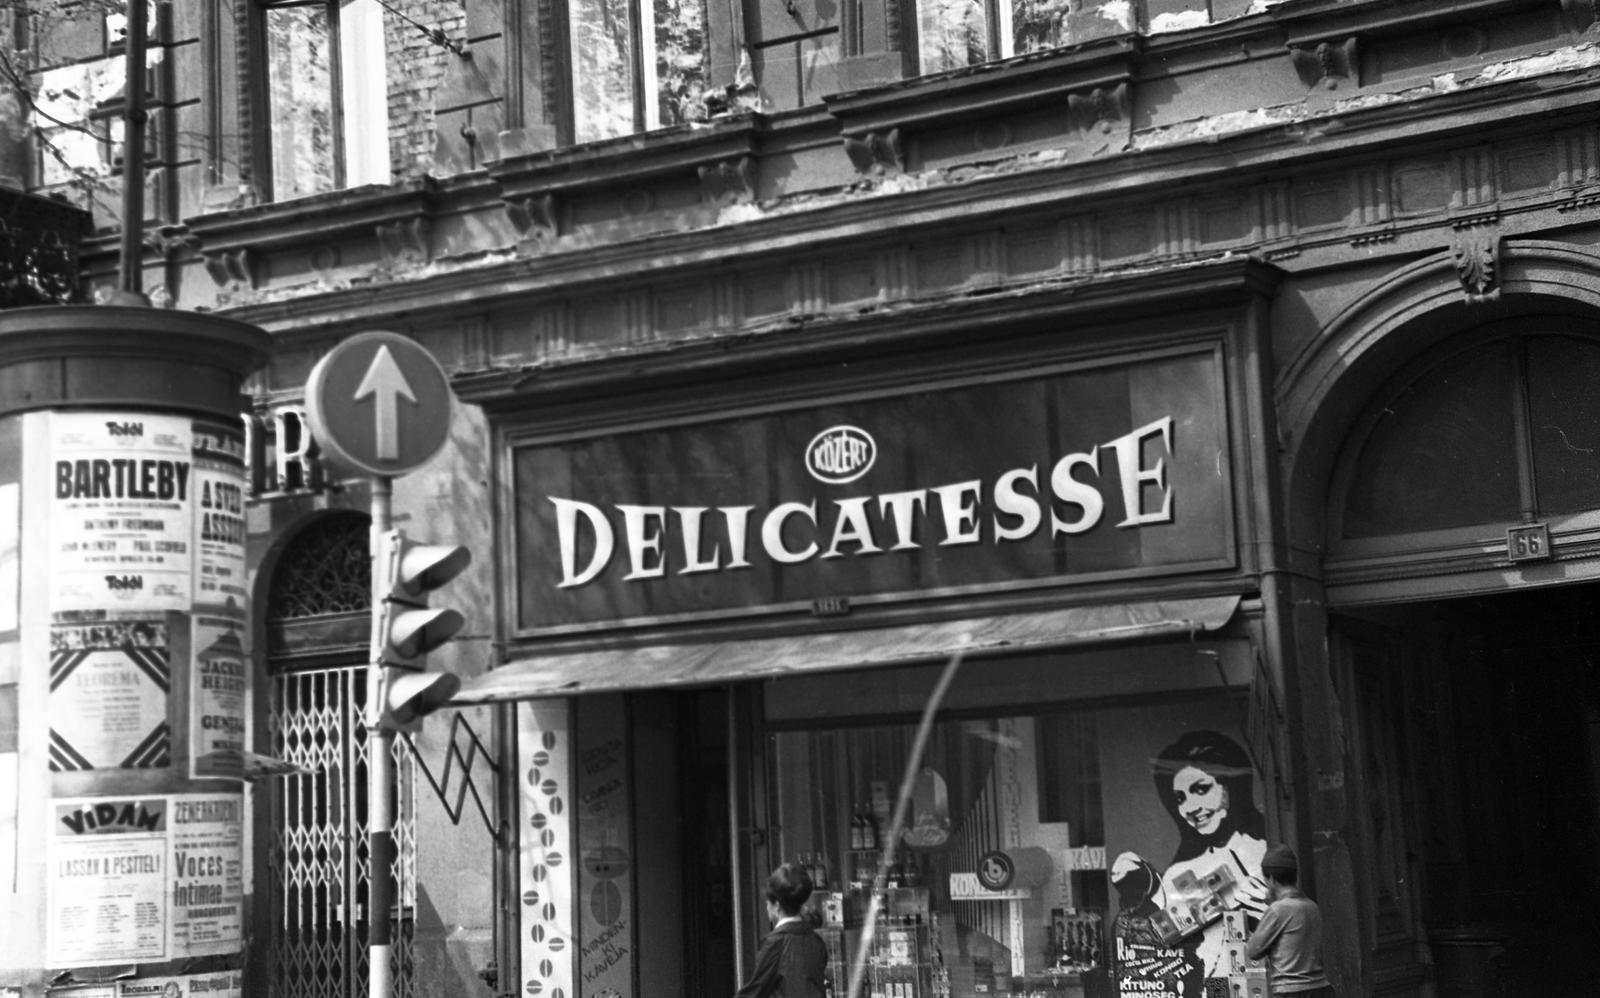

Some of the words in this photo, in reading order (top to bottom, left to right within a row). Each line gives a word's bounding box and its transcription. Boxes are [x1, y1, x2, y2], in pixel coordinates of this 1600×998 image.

[814, 430, 868, 474] KÖZÉRT
[55, 458, 190, 501] BARTLEBY
[547, 415, 1177, 589] DELICATESSE
[1516, 534, 1540, 555] 66
[175, 851, 223, 878] Voces
[174, 880, 223, 907] Intimae
[1173, 963, 1195, 979] TEA
